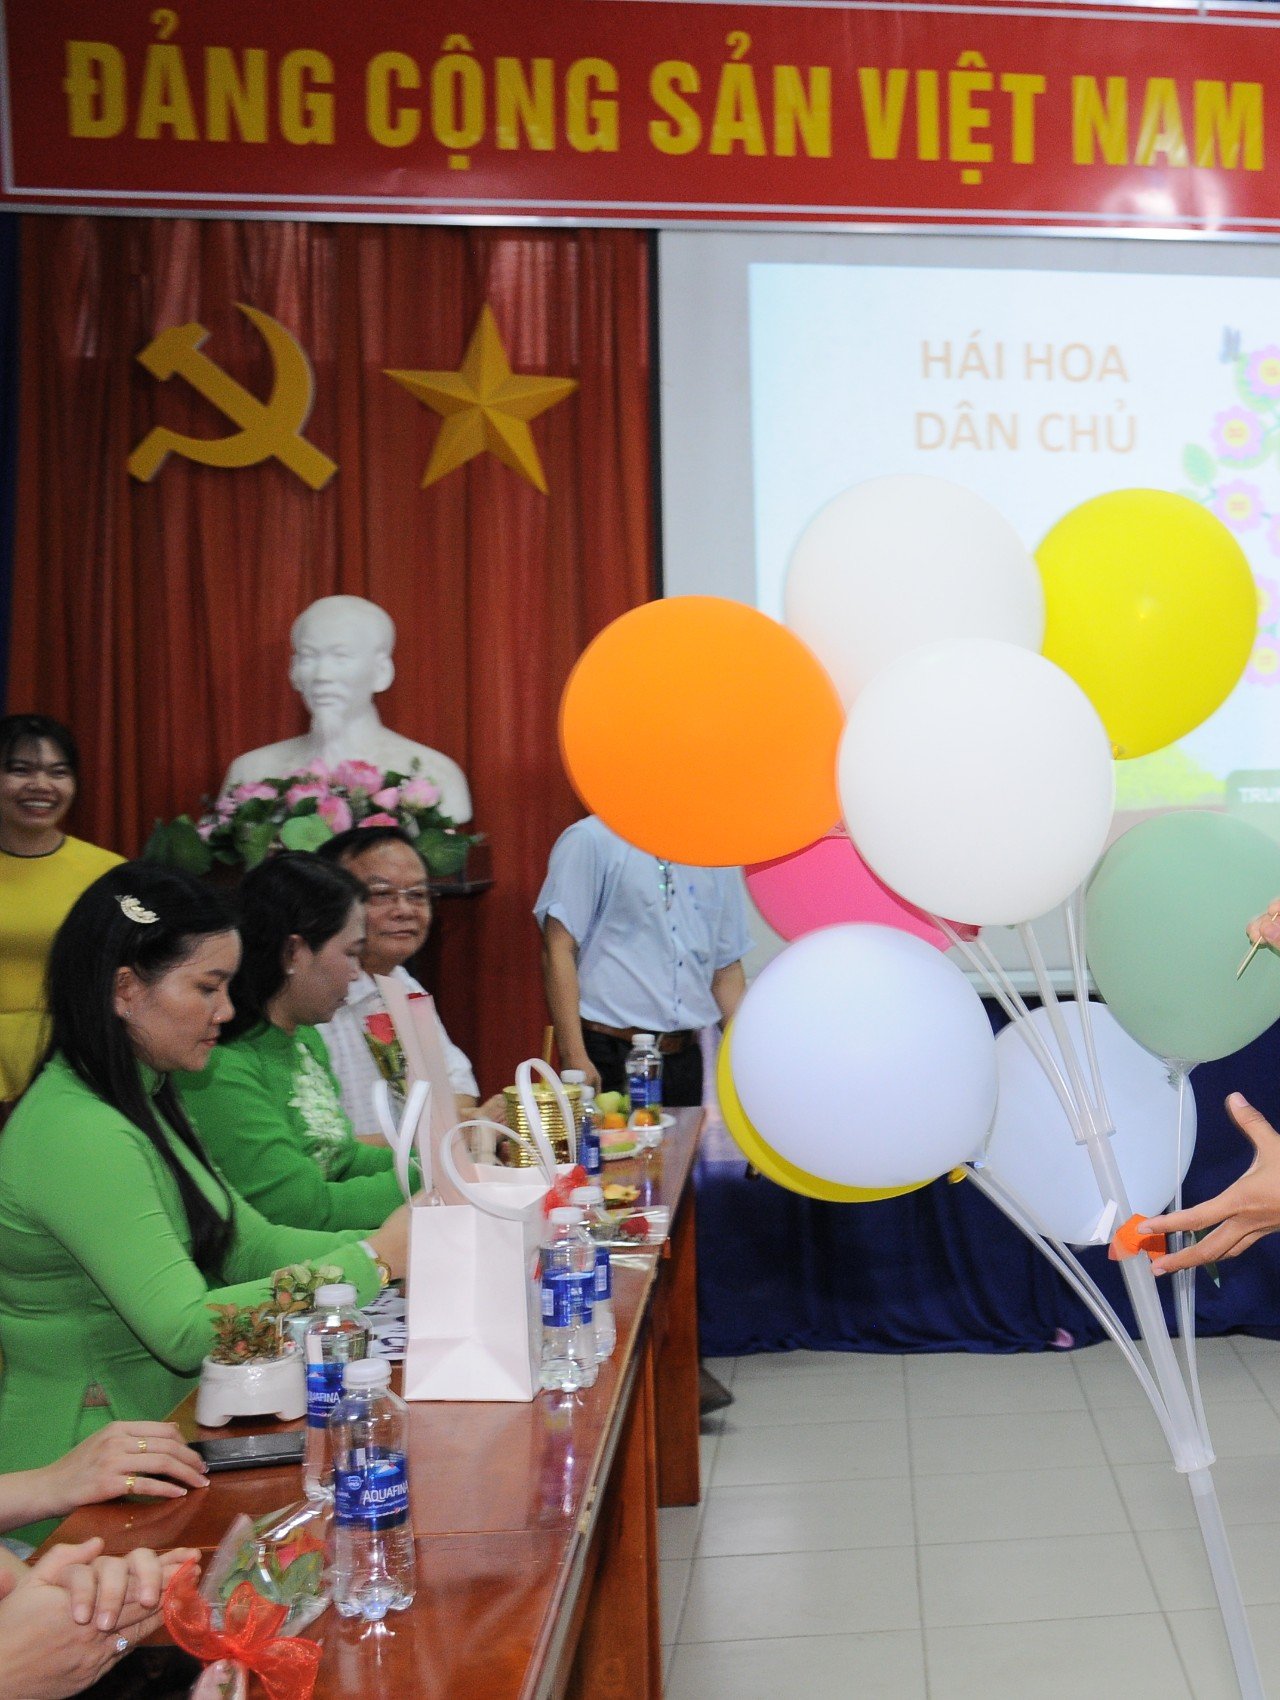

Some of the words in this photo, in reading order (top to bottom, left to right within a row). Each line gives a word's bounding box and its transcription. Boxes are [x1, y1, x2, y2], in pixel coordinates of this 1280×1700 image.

[64, 8, 335, 147] ĐẢNG
[366, 33, 619, 170] CỘNG
[649, 31, 832, 158] SẢN
[859, 50, 1047, 185] VIỆT
[1071, 75, 1265, 172] NAM
[920, 329, 1004, 380] HÁI
[1023, 341, 1130, 383] HOA
[915, 399, 1019, 452] DÂN
[1037, 398, 1138, 454] CHỦ
